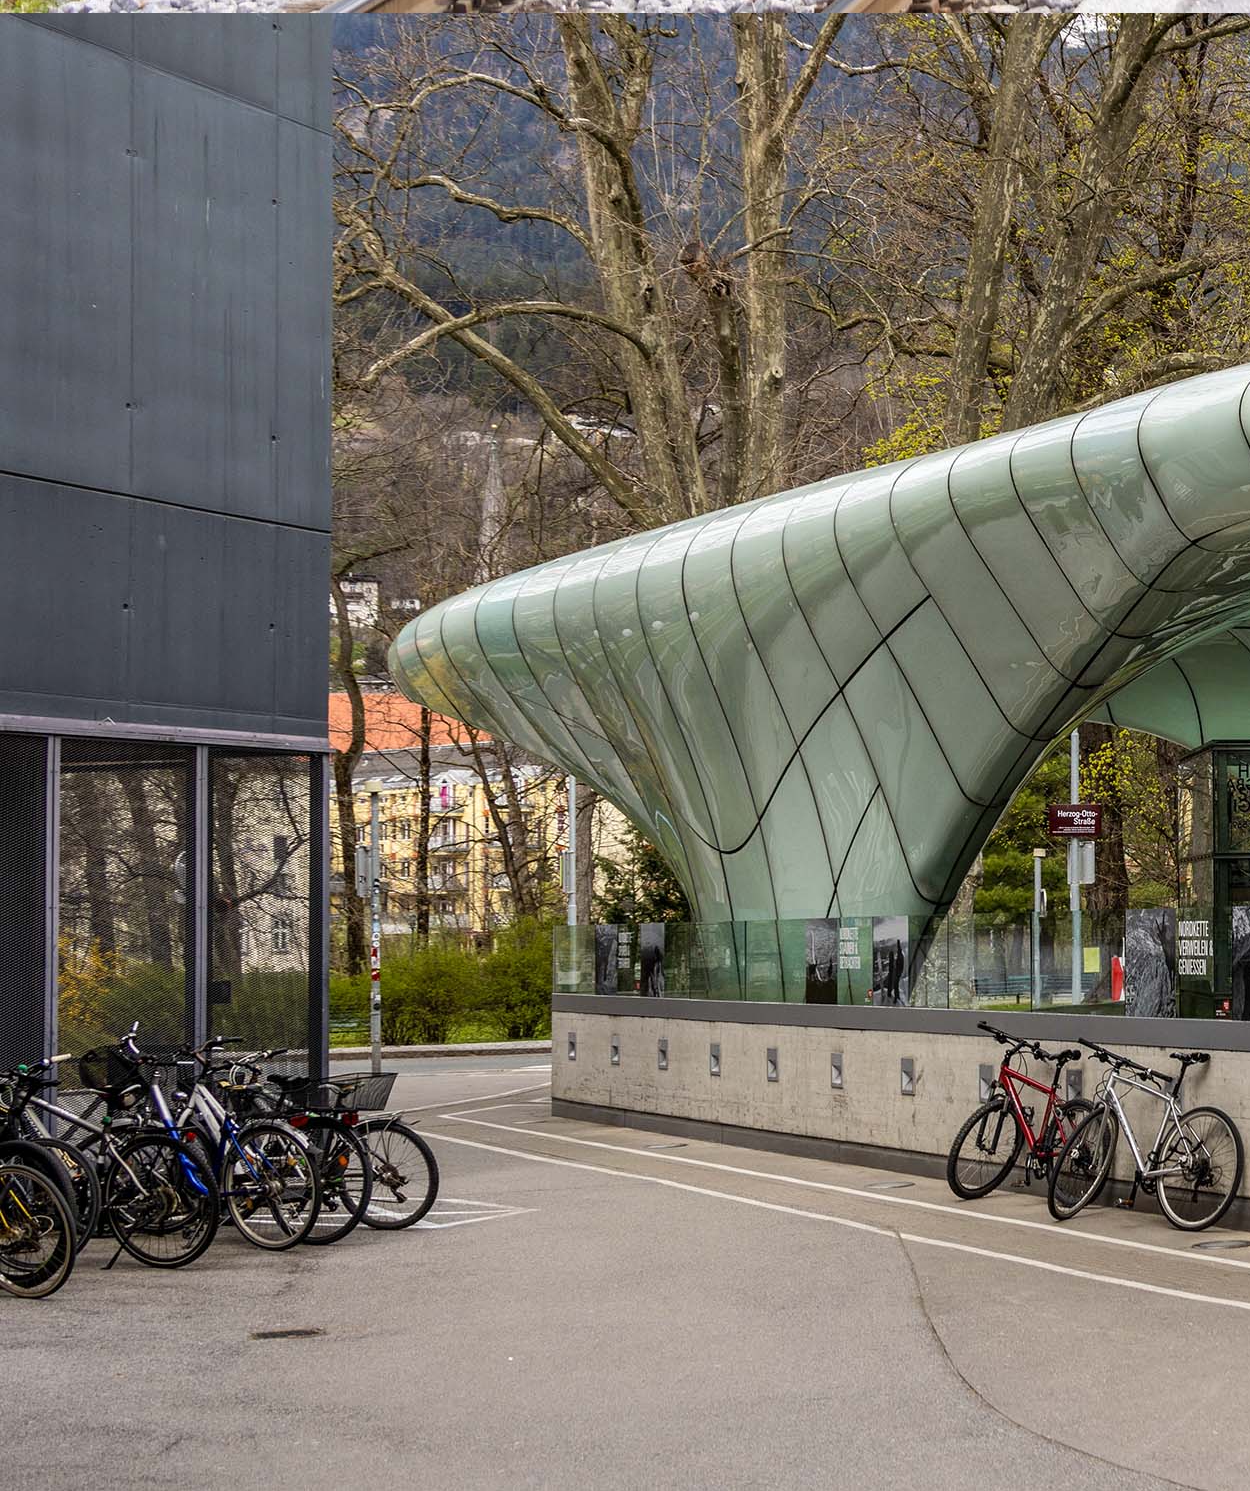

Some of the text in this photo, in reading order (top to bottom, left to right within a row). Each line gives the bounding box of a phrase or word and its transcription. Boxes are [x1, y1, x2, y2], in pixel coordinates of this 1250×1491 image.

[1057, 810, 1098, 818] Herzog-Otto-
[1178, 920, 1209, 937] NORDKETTE
[1178, 940, 1208, 956] VERWEILEN
[1178, 959, 1207, 976] GENIESSEN
